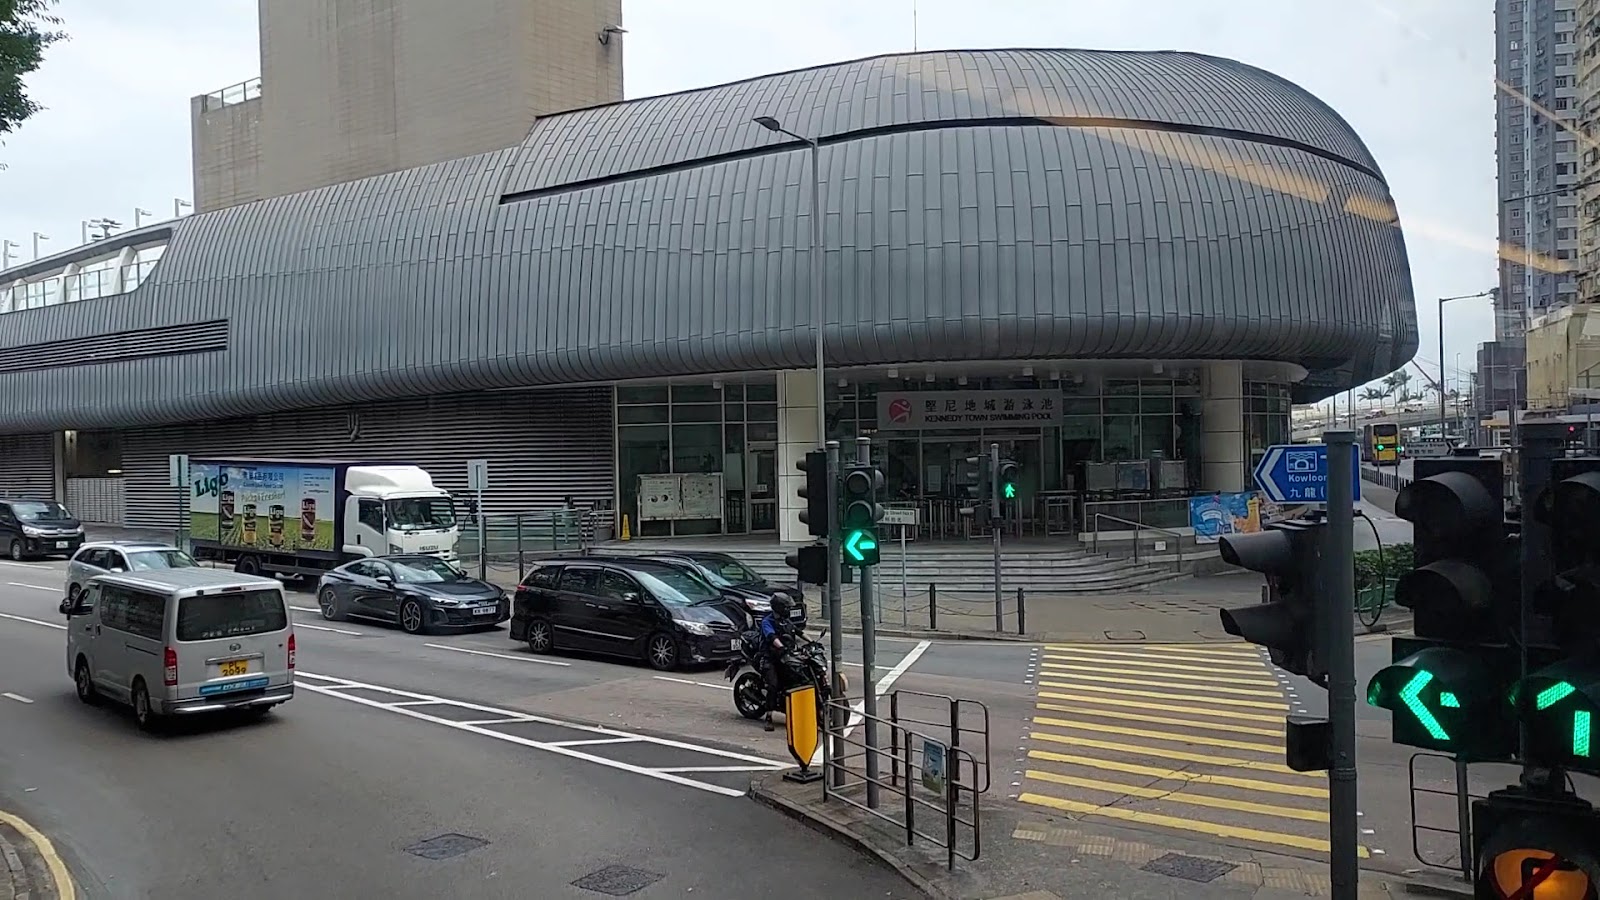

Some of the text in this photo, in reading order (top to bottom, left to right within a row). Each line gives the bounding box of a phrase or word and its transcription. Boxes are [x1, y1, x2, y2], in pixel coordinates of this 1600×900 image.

[924, 398, 1054, 412] 堅尼地城游泳池
[924, 411, 1053, 423] KENNEDY TOWN SWIMMING POOL
[194, 473, 229, 497] Ligo
